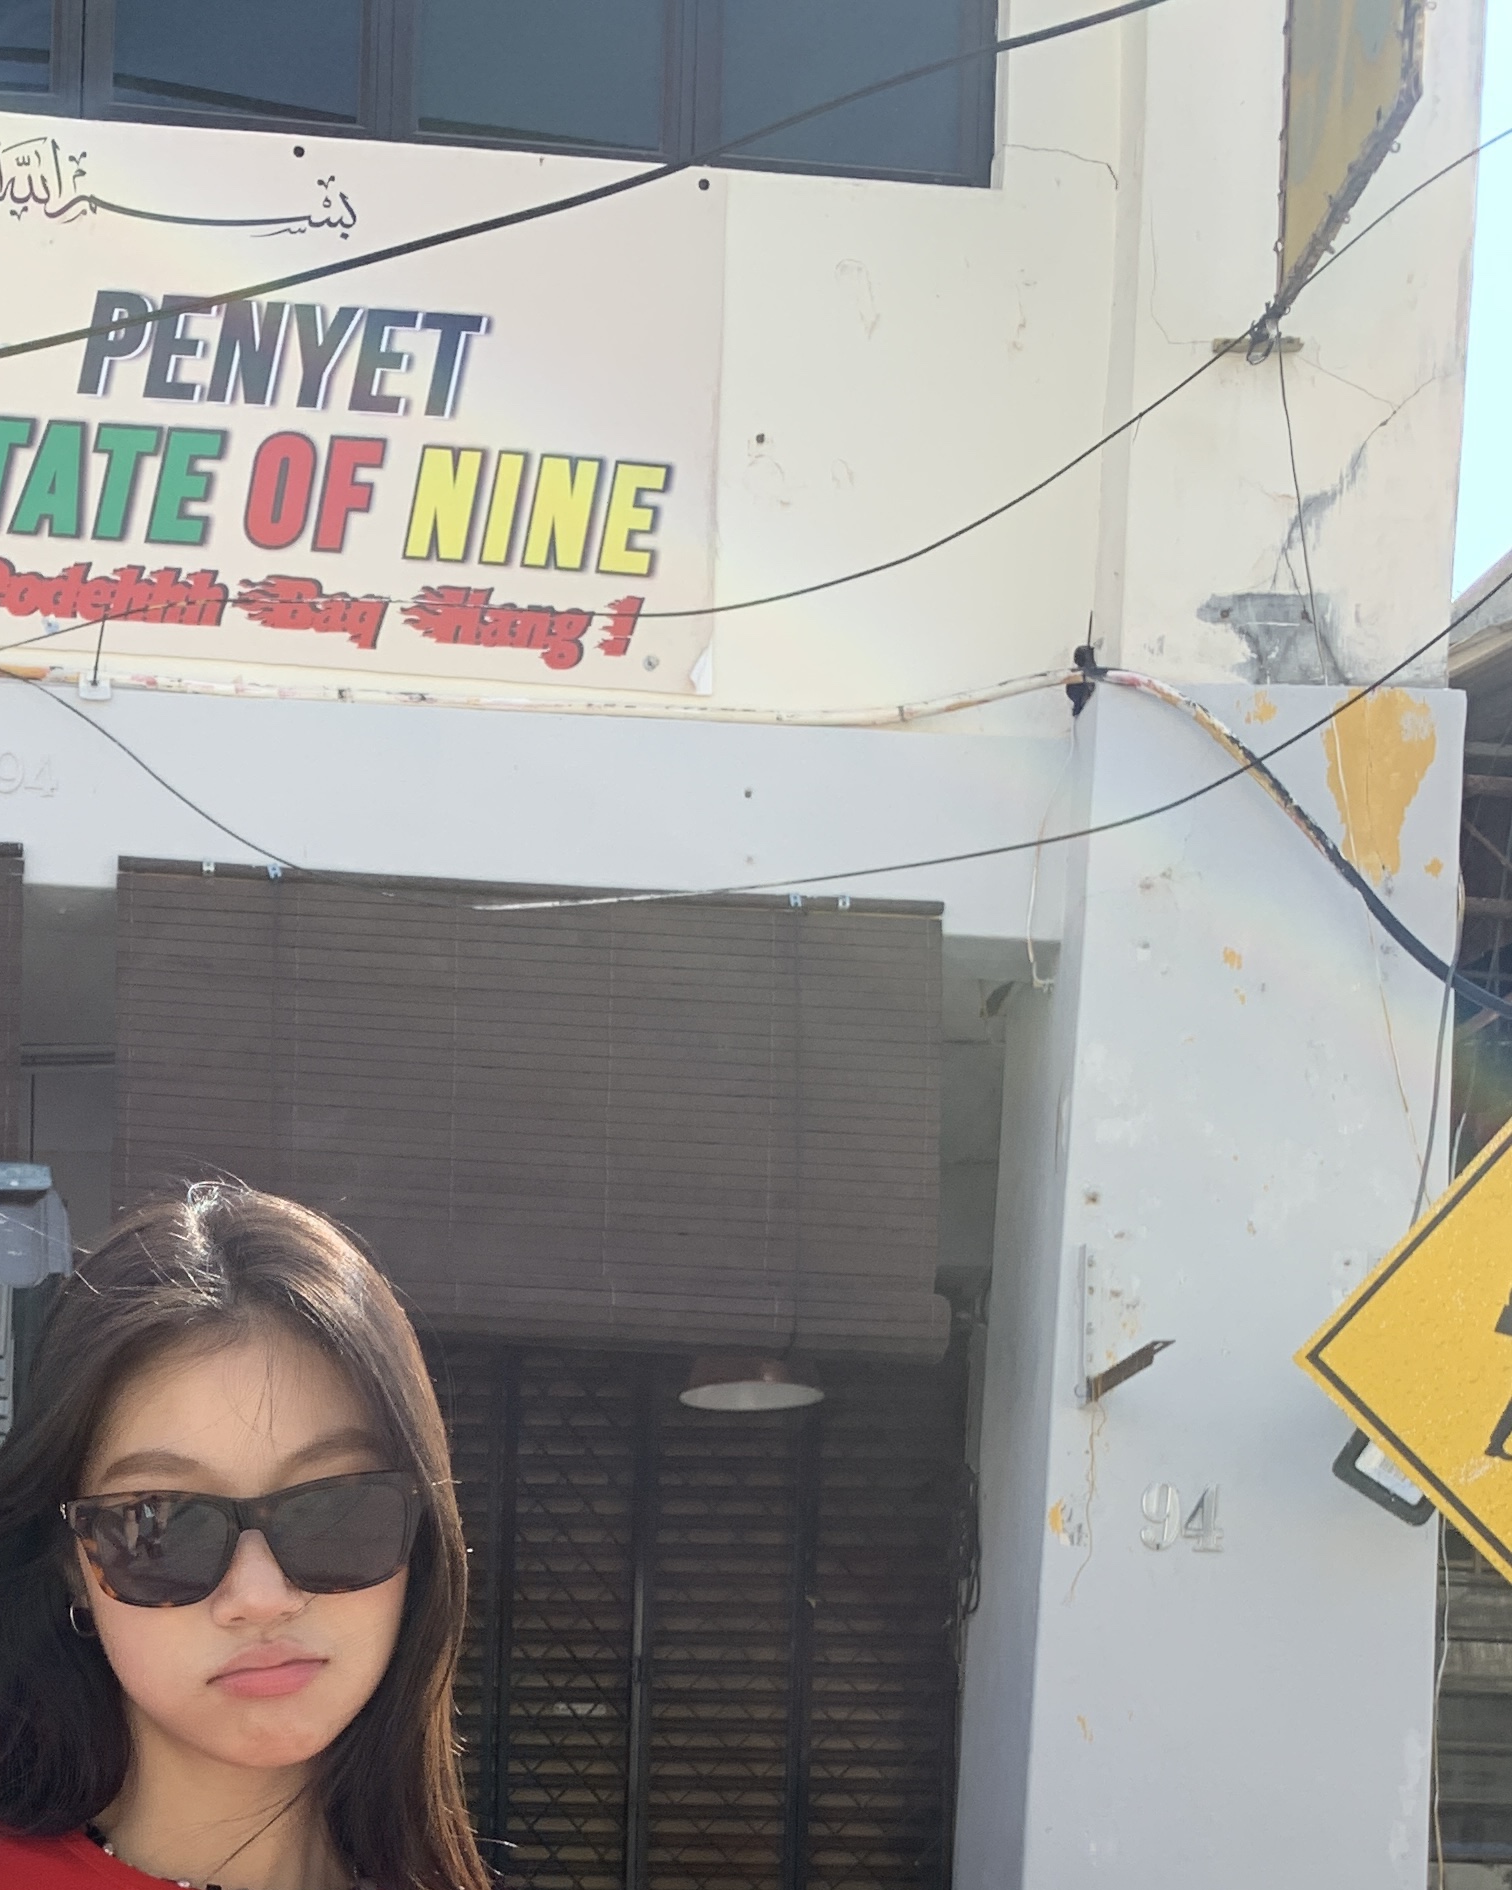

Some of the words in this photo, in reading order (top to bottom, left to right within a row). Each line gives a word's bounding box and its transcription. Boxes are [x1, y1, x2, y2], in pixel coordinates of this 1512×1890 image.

[77, 289, 492, 417] PENYET
[243, 431, 387, 555] OF
[404, 444, 674, 579] NINE
[1140, 1482, 1224, 1552] 94
